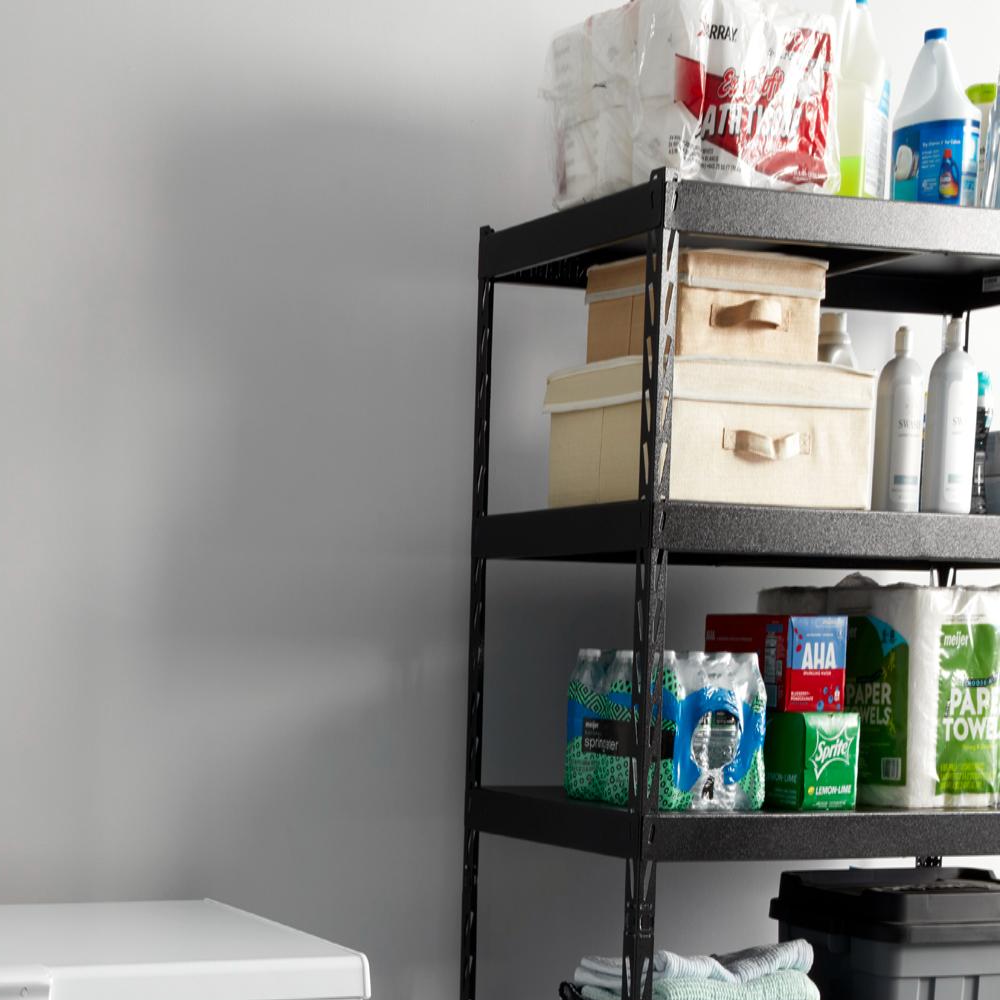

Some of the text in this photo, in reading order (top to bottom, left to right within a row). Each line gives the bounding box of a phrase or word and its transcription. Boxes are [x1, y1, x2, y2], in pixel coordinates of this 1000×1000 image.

[705, 24, 738, 42] RRAY
[697, 102, 743, 139] ATH
[944, 631, 970, 649] meijer
[801, 641, 837, 670] AHA
[846, 682, 892, 706] PAPER
[815, 739, 848, 763] Sprite
[816, 784, 851, 796] LEMON-LIME
